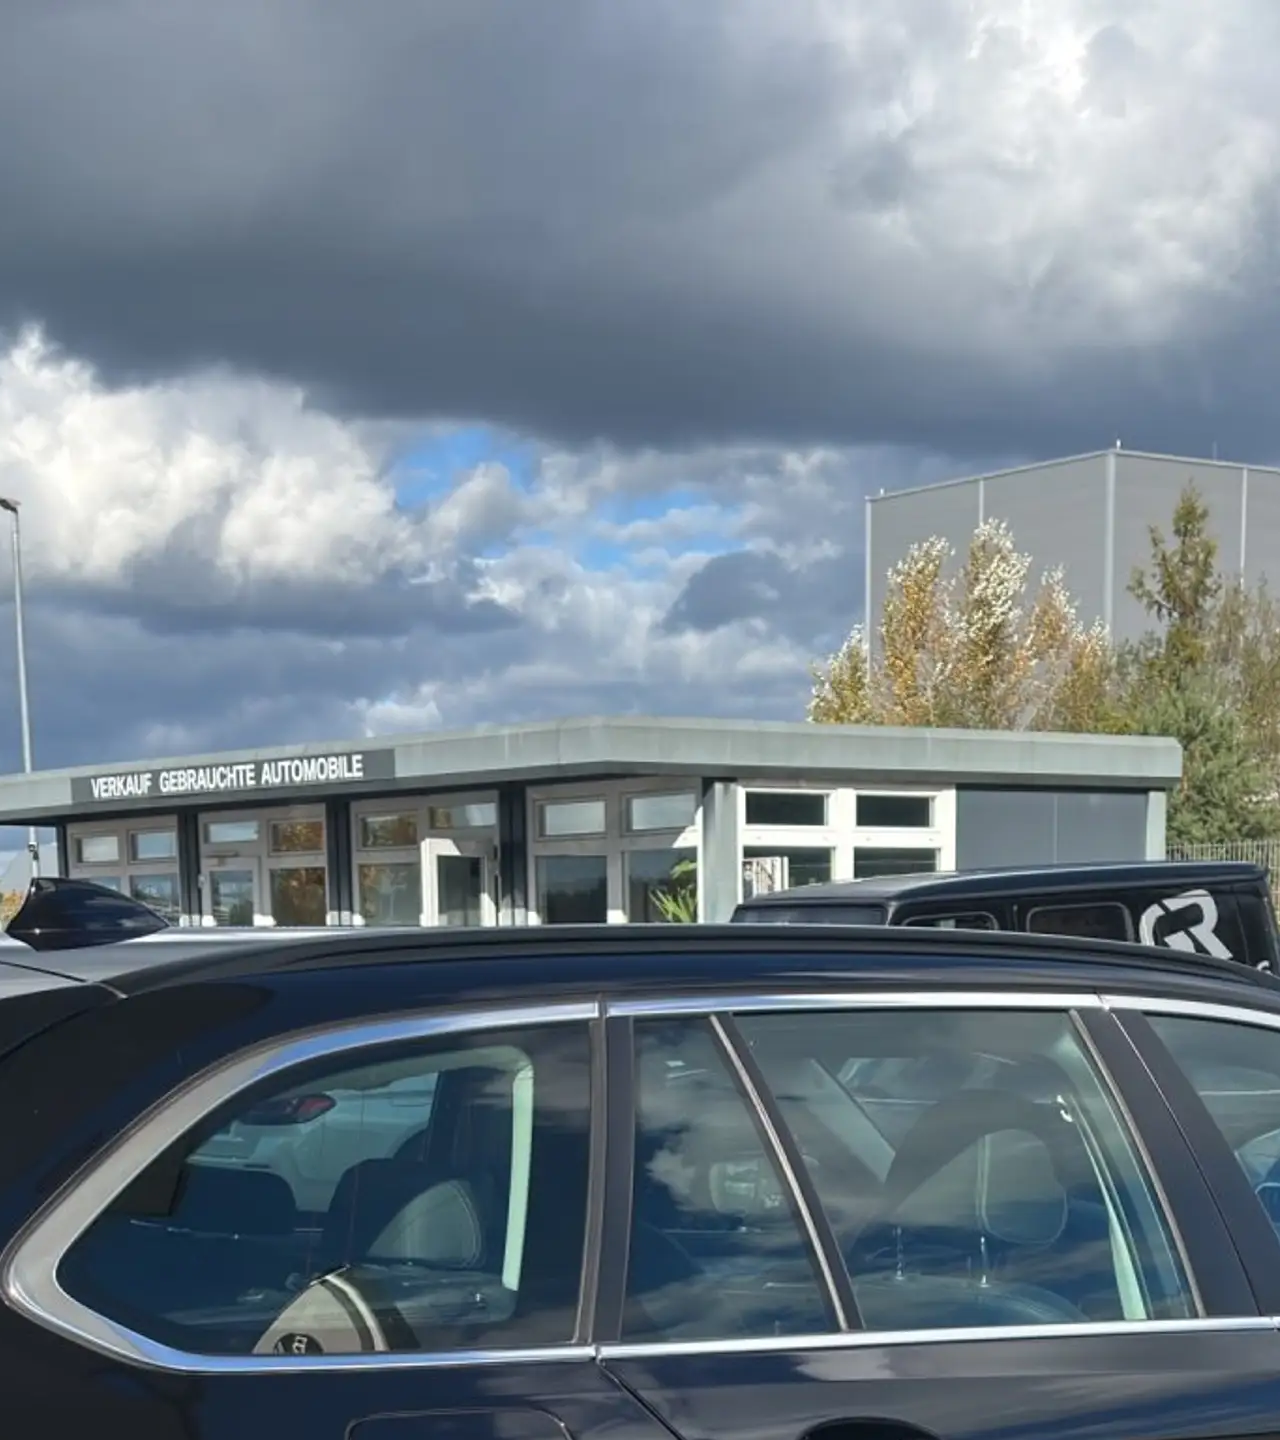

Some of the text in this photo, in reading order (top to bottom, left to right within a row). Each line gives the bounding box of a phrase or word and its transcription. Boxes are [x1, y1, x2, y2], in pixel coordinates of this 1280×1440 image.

[90, 753, 364, 799] VERKAUF GEBRAUCHTE AUTOMOBILE
